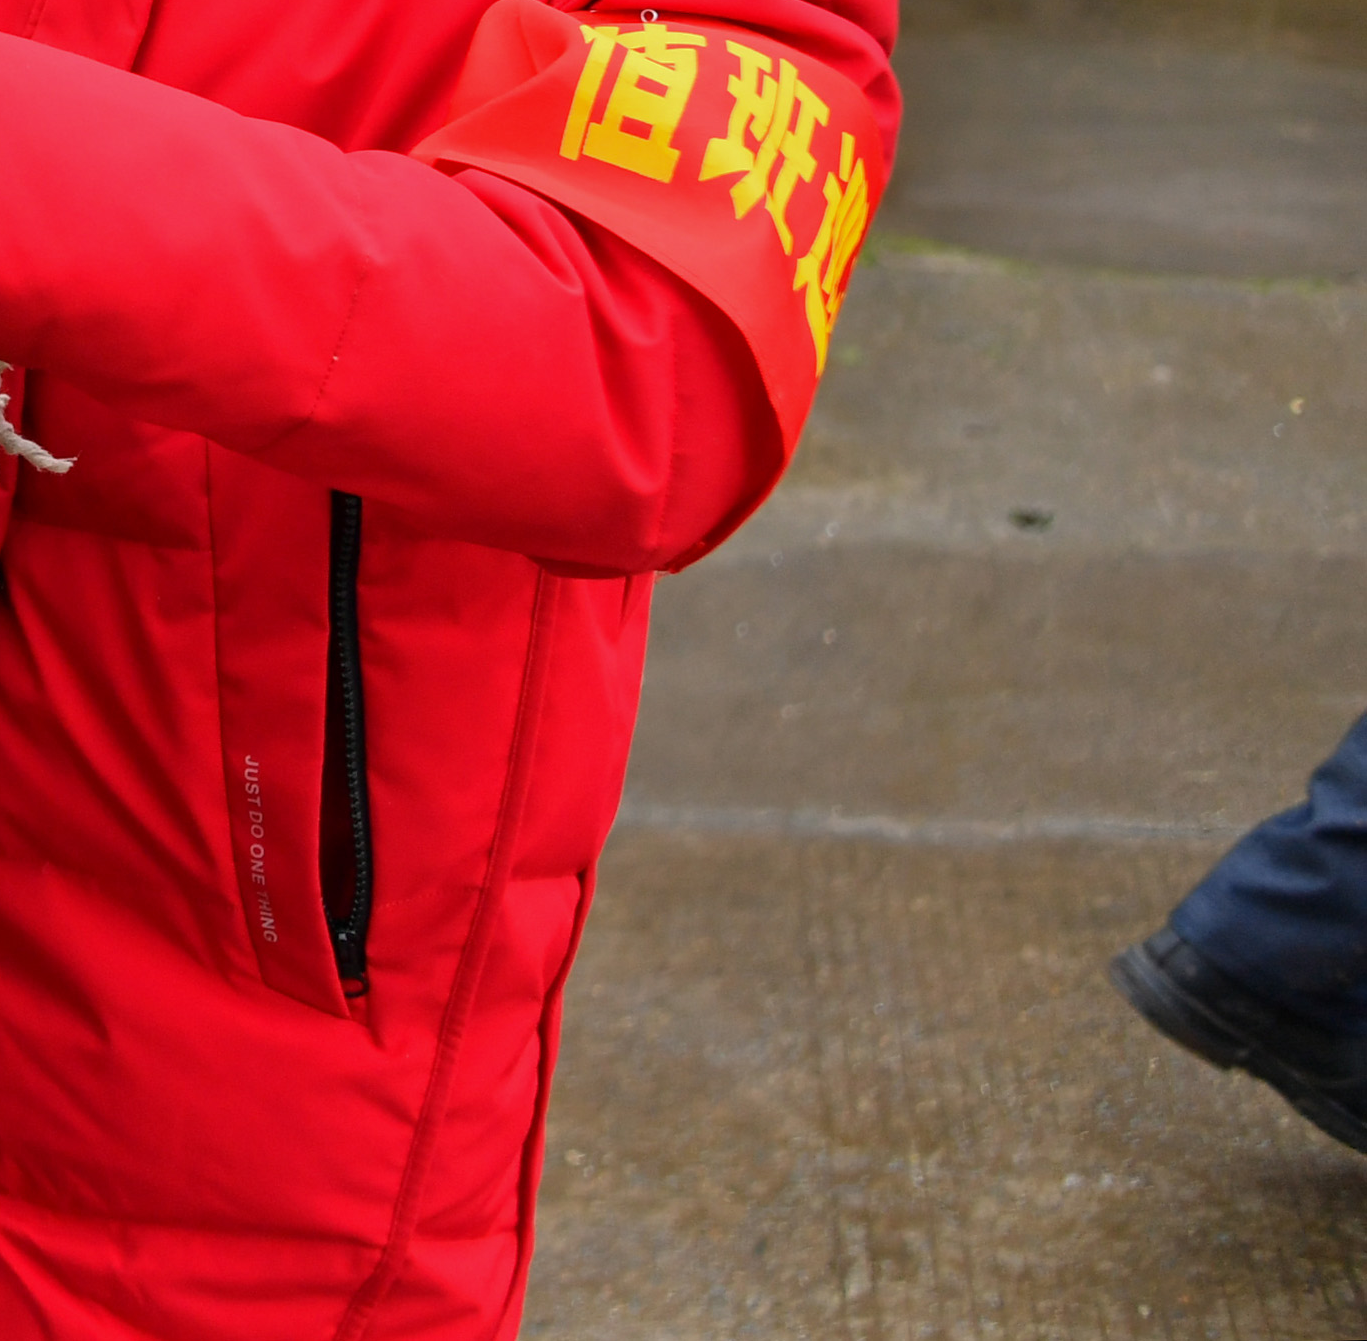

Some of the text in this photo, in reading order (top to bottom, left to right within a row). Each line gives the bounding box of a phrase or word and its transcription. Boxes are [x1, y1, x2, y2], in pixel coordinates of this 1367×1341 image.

[244, 754, 278, 943] JUST DO ONE THING
